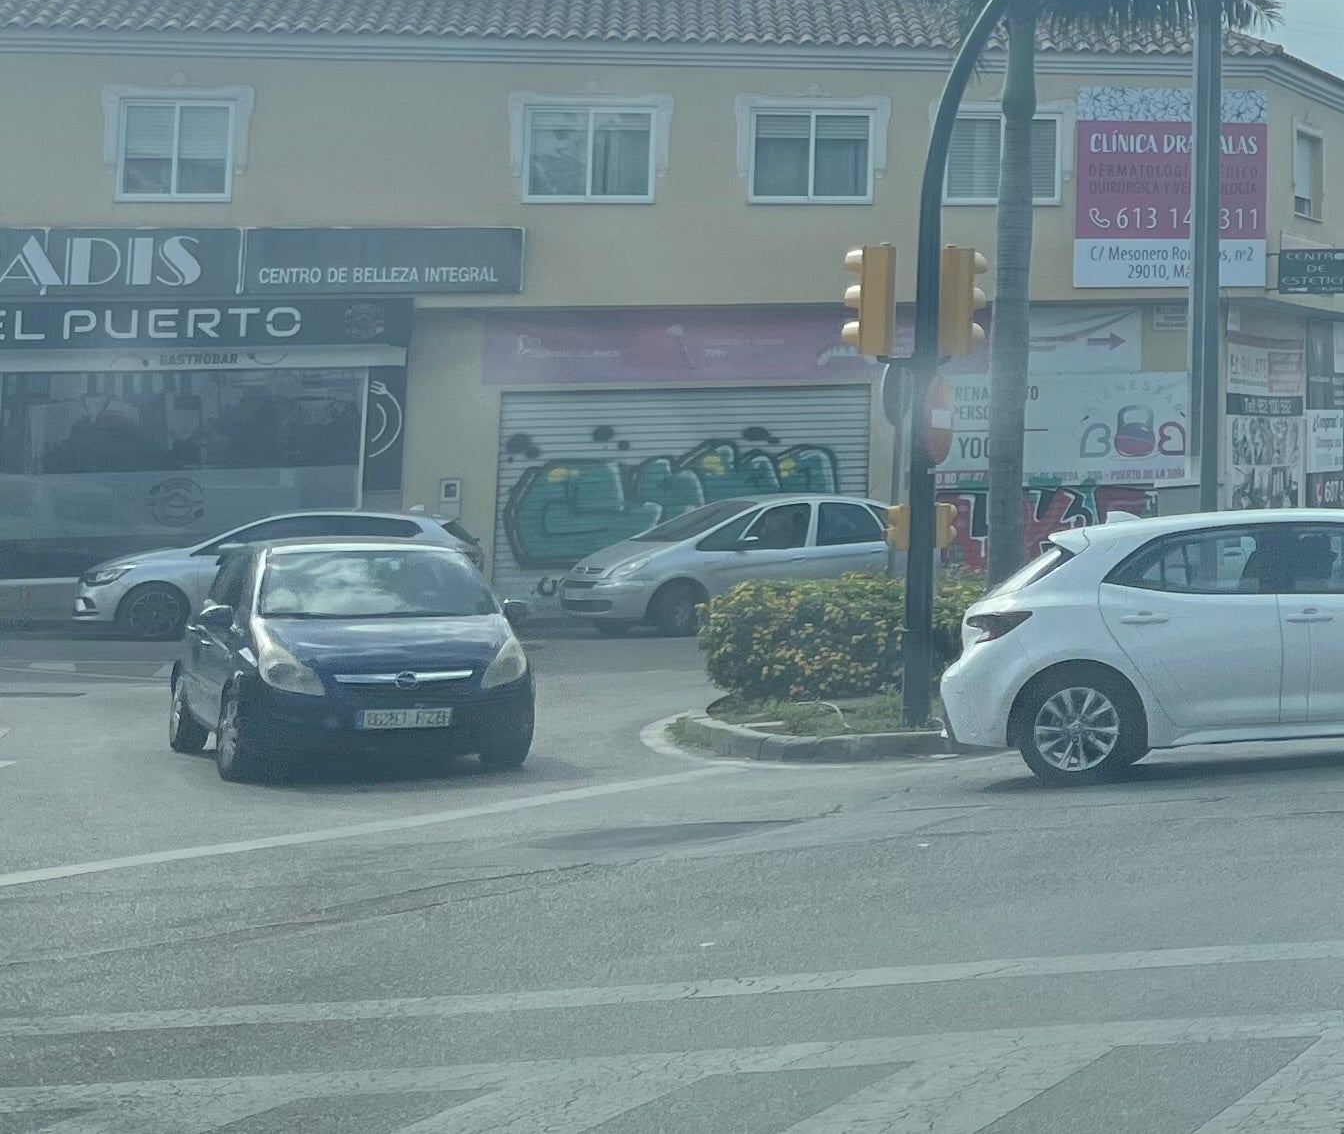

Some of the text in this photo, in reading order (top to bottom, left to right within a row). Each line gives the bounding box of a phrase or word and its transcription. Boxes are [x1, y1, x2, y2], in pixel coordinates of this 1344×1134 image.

[1089, 129, 1158, 154] CLÍNICA
[1219, 135, 1258, 155] ALAS
[1088, 163, 1190, 178] DERMATOLOGÍ
[1116, 207, 1158, 230] 613
[1219, 207, 1258, 230] 311
[1090, 246, 1105, 262] C/
[1108, 246, 1168, 261] Mesonero
[258, 266, 499, 284] CENTRO DE BELLEZA INTEGRAL
[1127, 264, 1170, 280] 29010,
[1306, 264, 1327, 273] DE
[0, 307, 302, 340] L PUERTO
[159, 353, 239, 365] GASTROBAR
